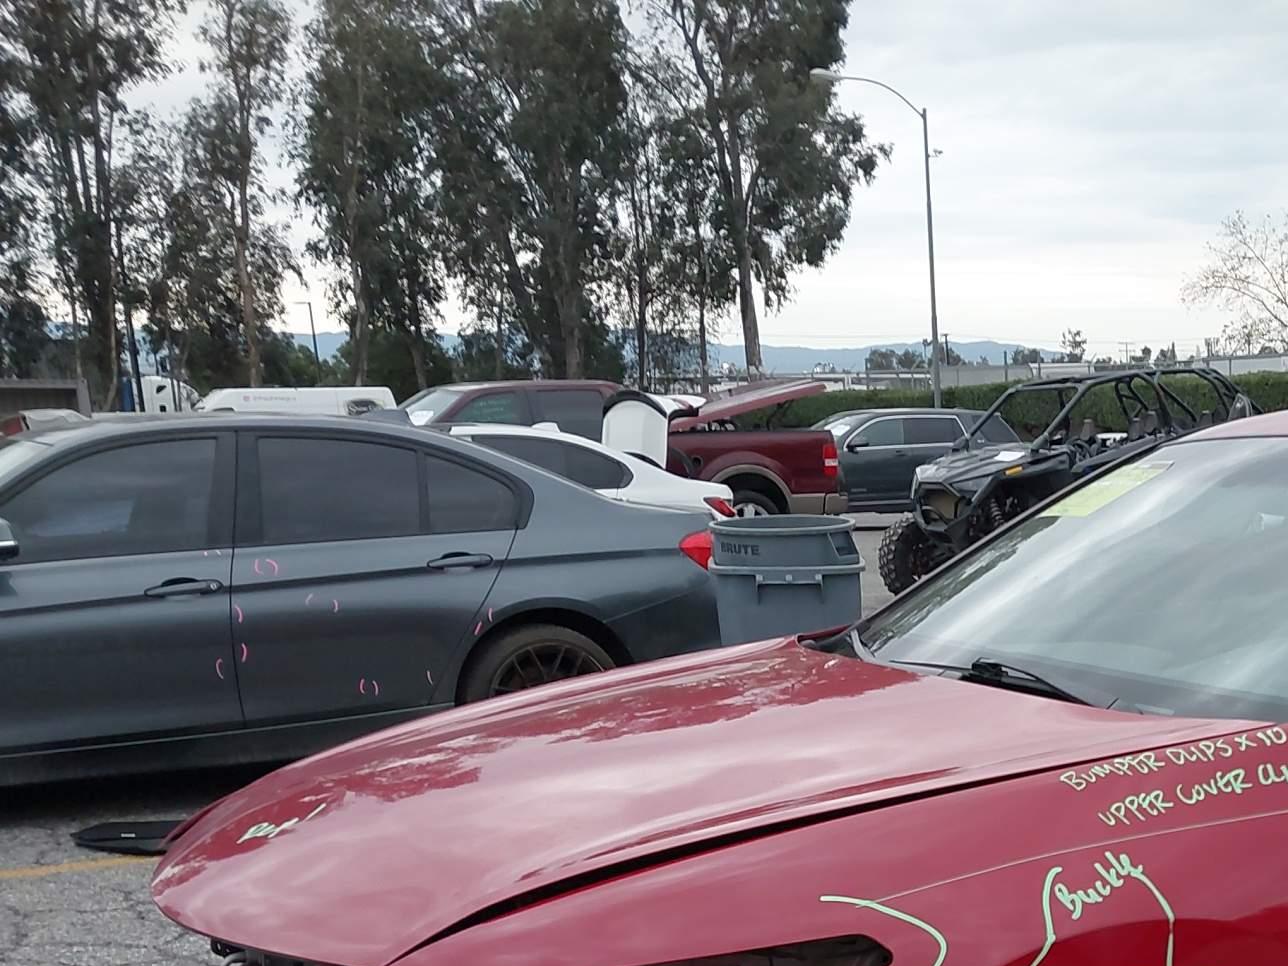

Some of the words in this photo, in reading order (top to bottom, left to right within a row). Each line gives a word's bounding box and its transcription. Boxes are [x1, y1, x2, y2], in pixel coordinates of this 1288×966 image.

[720, 541, 760, 556] BRUTE
[1059, 751, 1166, 791] BUMPER
[1165, 738, 1233, 765] CLIPS
[1097, 790, 1174, 826] UPPER
[1176, 768, 1253, 805] COVER
